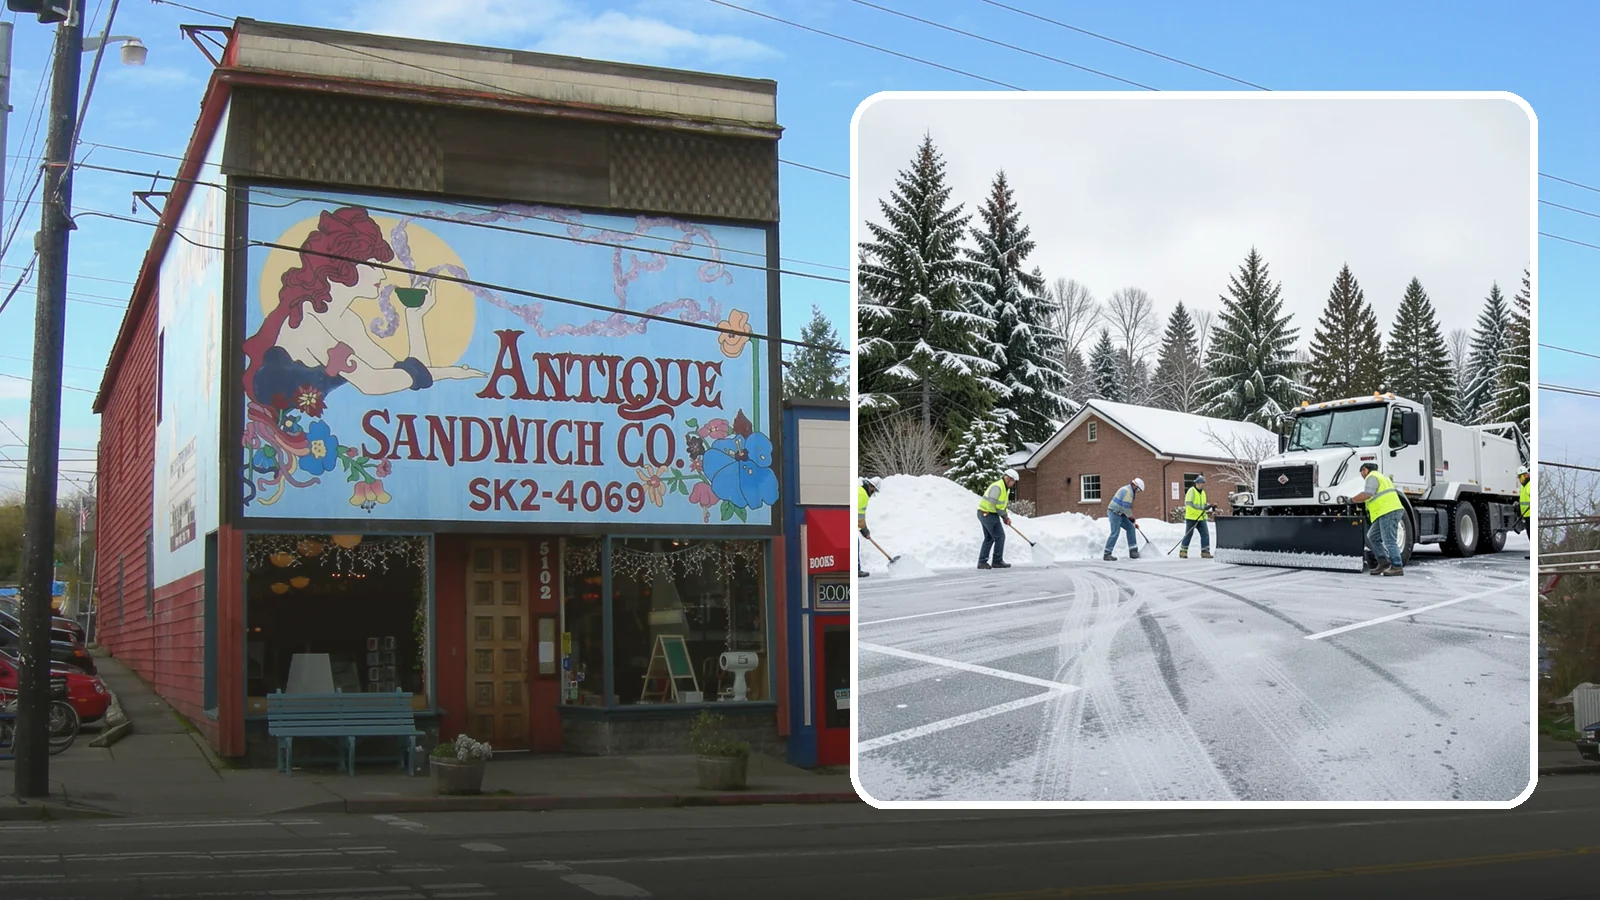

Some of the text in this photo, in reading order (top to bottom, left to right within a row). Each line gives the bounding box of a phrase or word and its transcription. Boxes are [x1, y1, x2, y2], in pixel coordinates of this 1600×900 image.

[476, 329, 724, 421] ANTIQUE
[360, 408, 685, 469] SANDWICH CO.
[468, 476, 646, 513] SK2-4069
[540, 541, 552, 600] 5102
[809, 555, 835, 569] BOOKS
